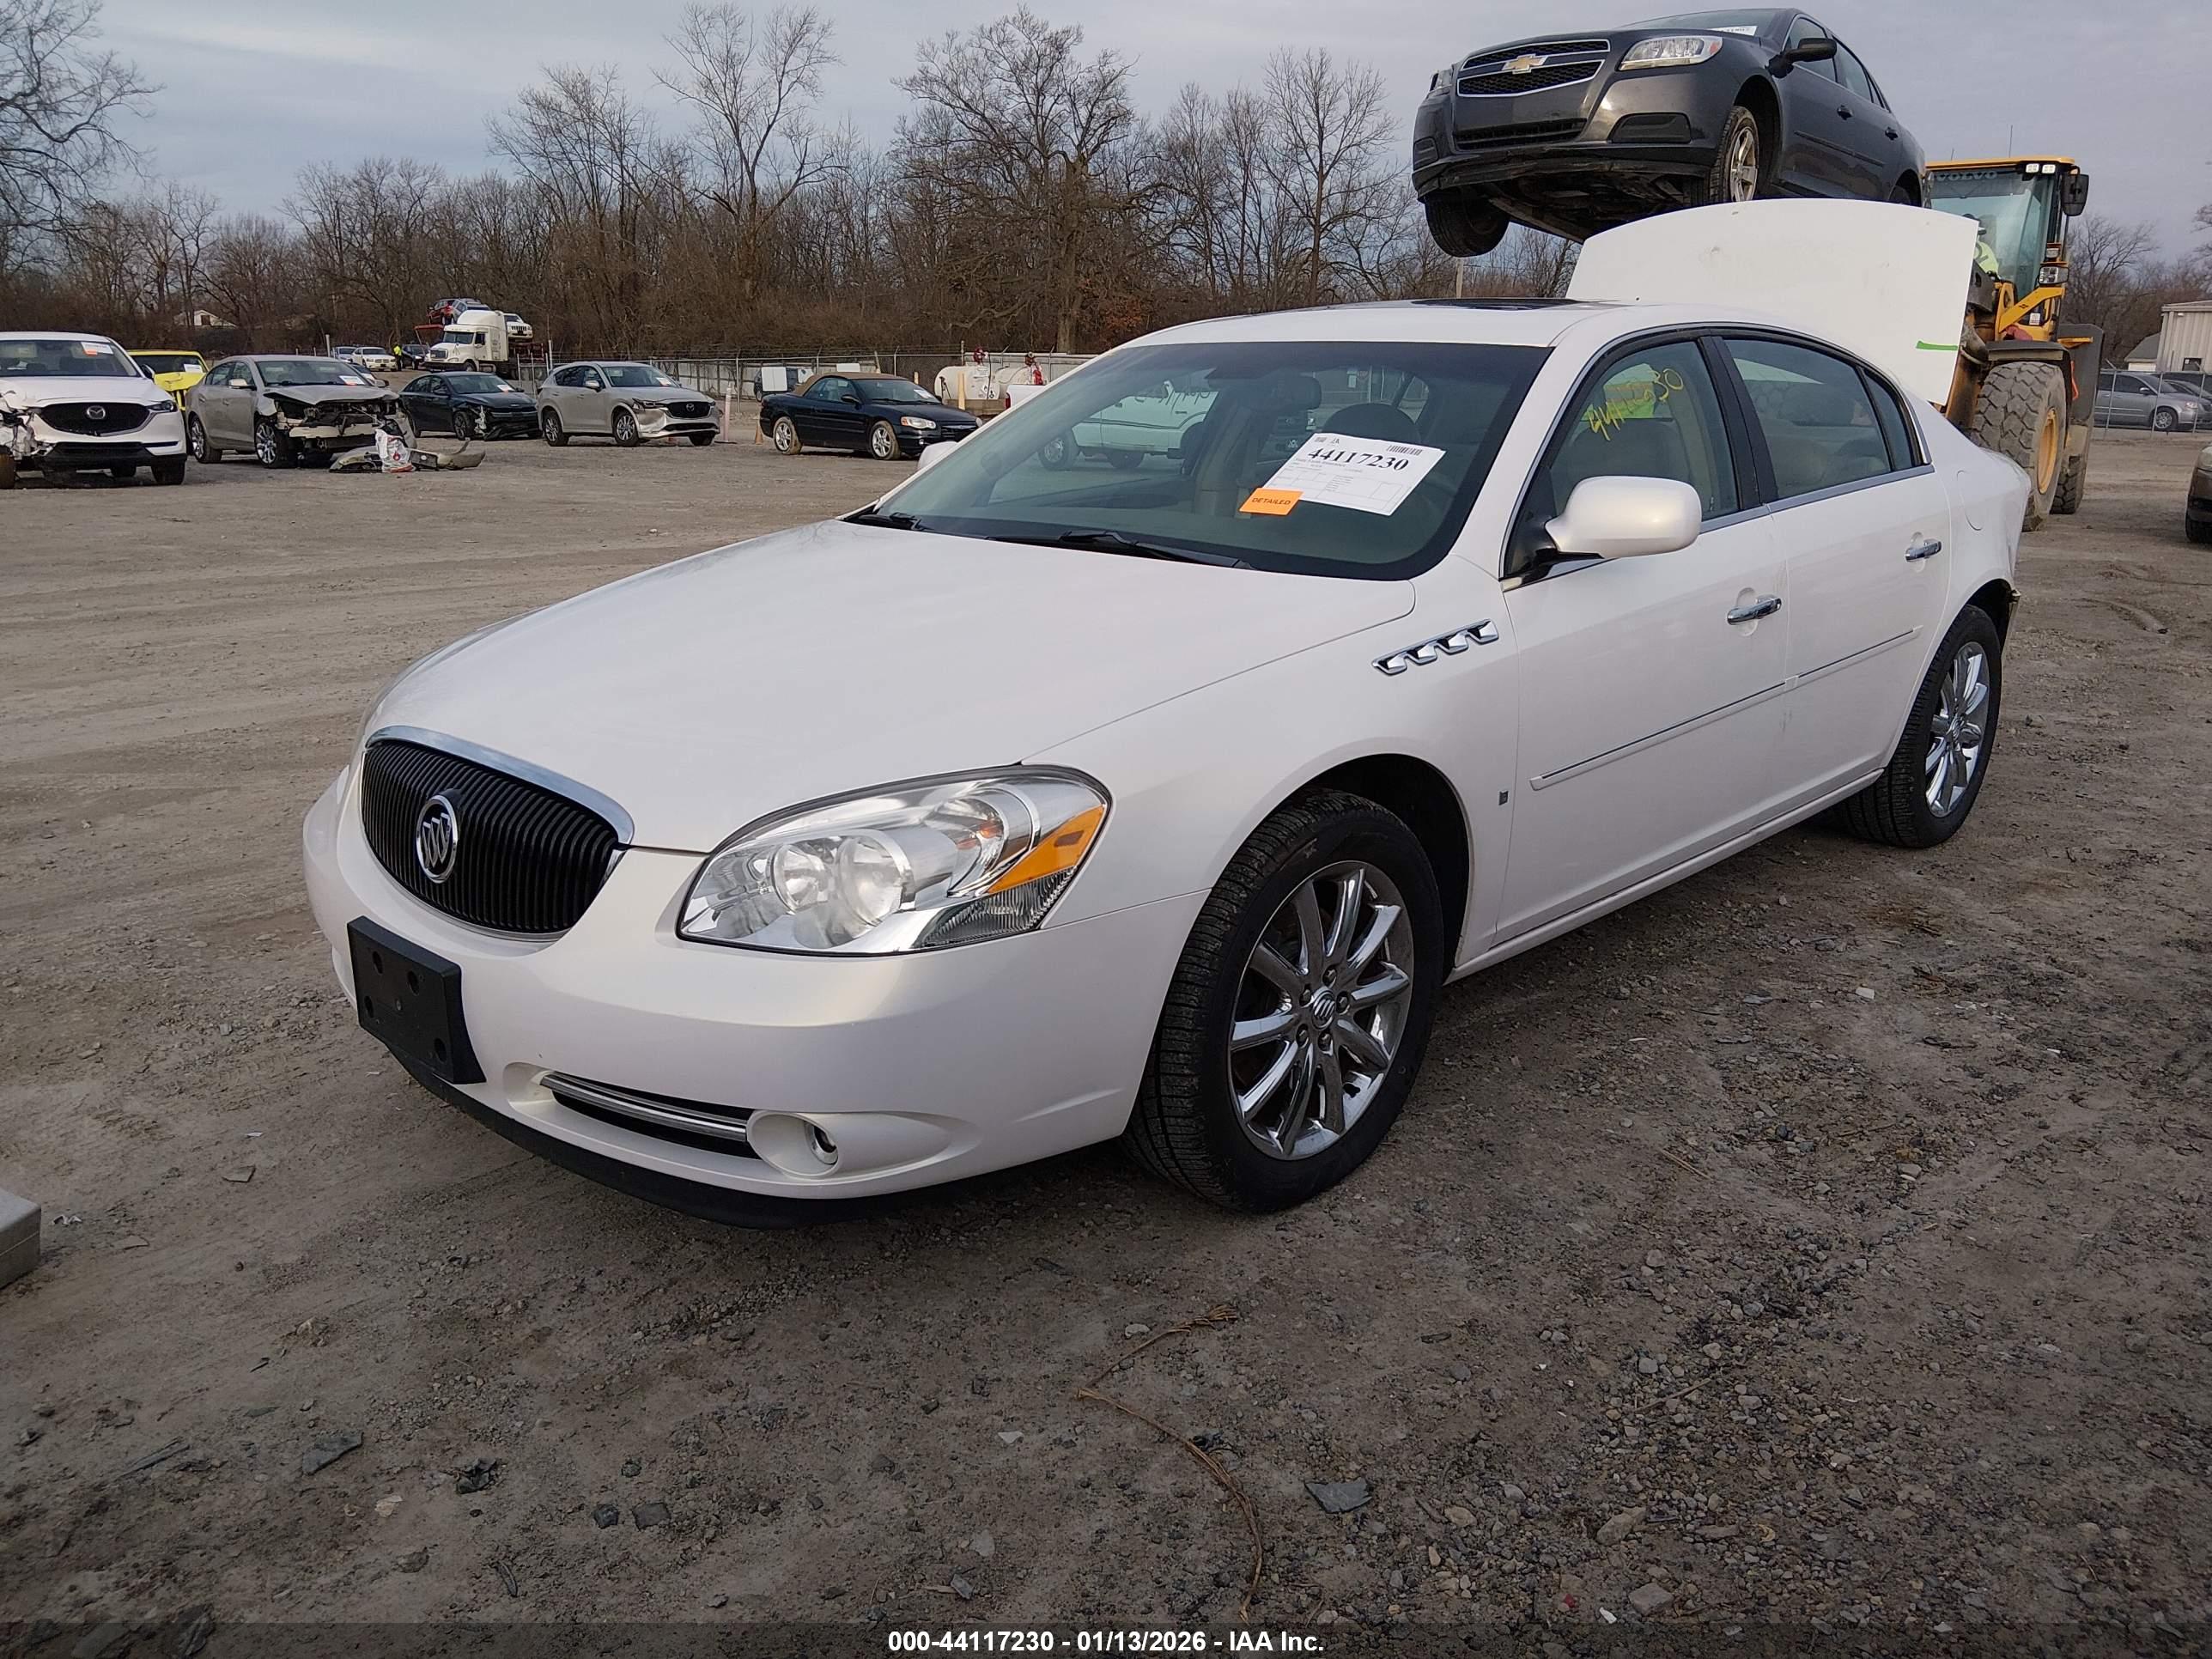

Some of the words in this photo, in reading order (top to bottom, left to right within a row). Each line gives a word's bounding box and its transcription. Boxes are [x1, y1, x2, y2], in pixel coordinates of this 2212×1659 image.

[1936, 170, 1998, 181] VOLVO
[1308, 448, 1409, 471] 44117230
[1251, 497, 1291, 506] DETAILED
